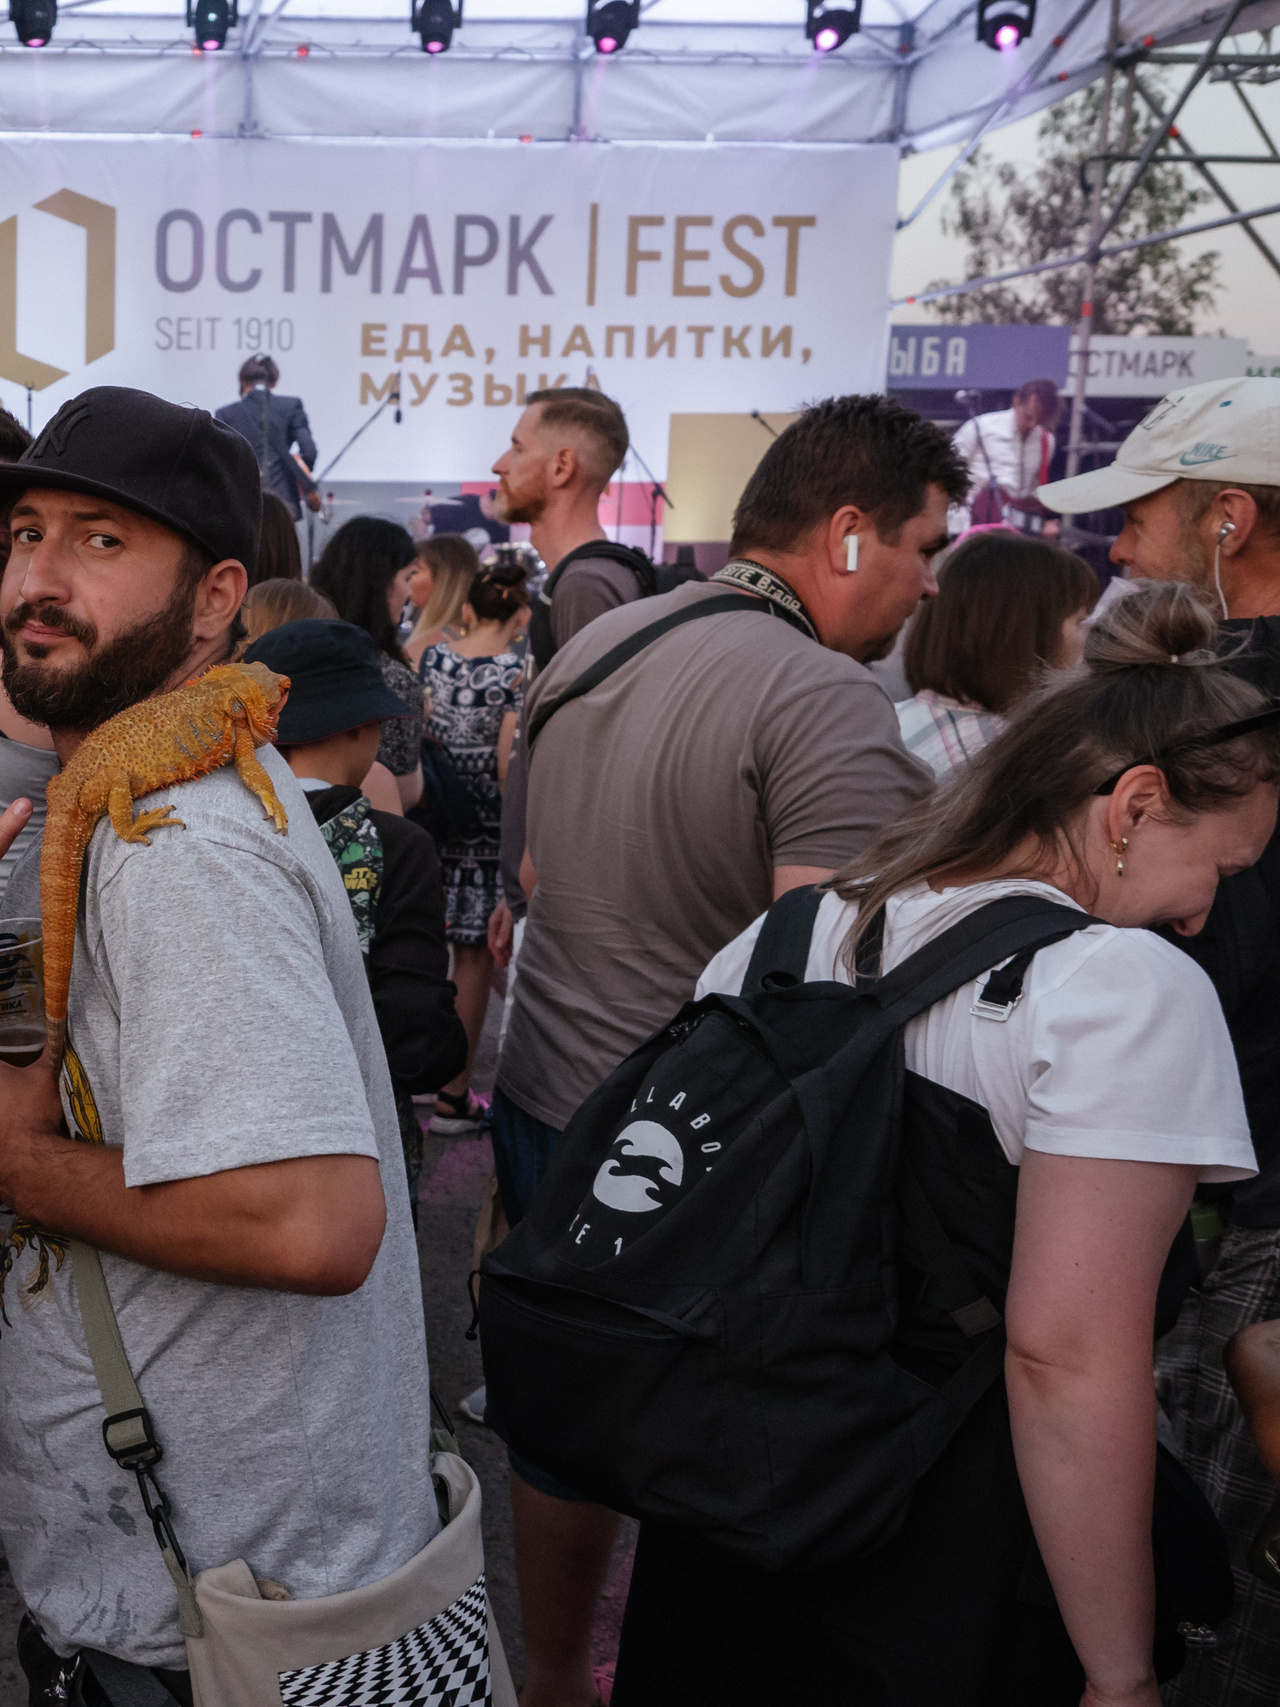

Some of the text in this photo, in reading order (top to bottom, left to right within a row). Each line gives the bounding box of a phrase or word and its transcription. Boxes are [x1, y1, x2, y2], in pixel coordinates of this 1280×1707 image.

[155, 208, 555, 296] ОСТМАРК
[626, 214, 817, 298] FEST
[155, 316, 294, 352] SEIT 1910
[361, 323, 812, 365] ЕДА, НАПИТКИ,
[890, 336, 968, 377] ЫБА
[1189, 442, 1228, 459] NIKE
